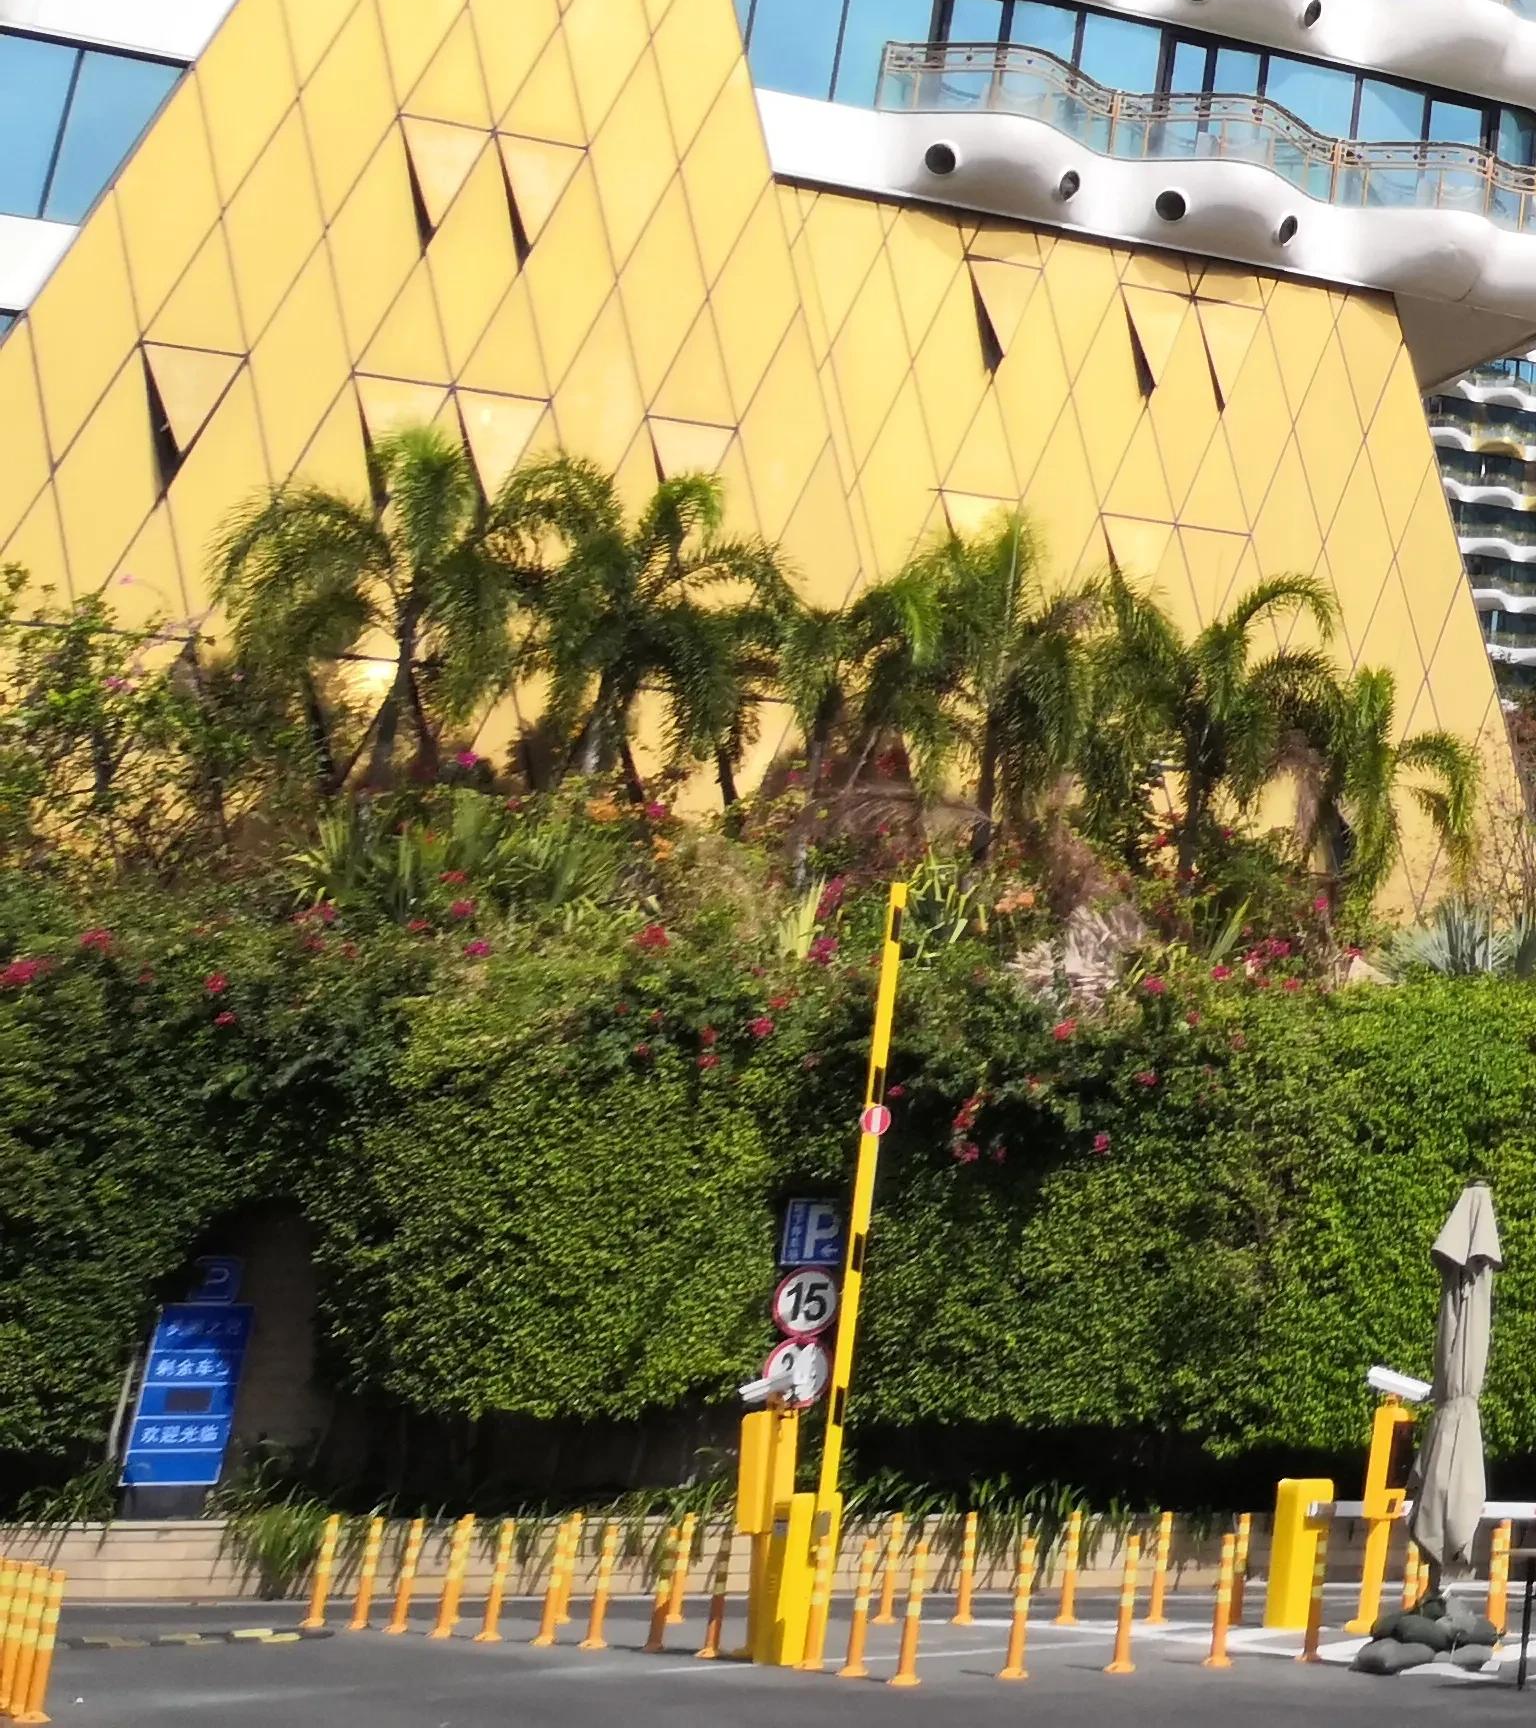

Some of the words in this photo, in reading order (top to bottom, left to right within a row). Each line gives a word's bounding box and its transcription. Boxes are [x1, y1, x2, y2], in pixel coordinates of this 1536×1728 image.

[805, 1203, 841, 1259] P
[786, 1281, 830, 1323] 15
[156, 1357, 230, 1377] 剩余车位
[140, 1424, 220, 1444] 欢迎光临
